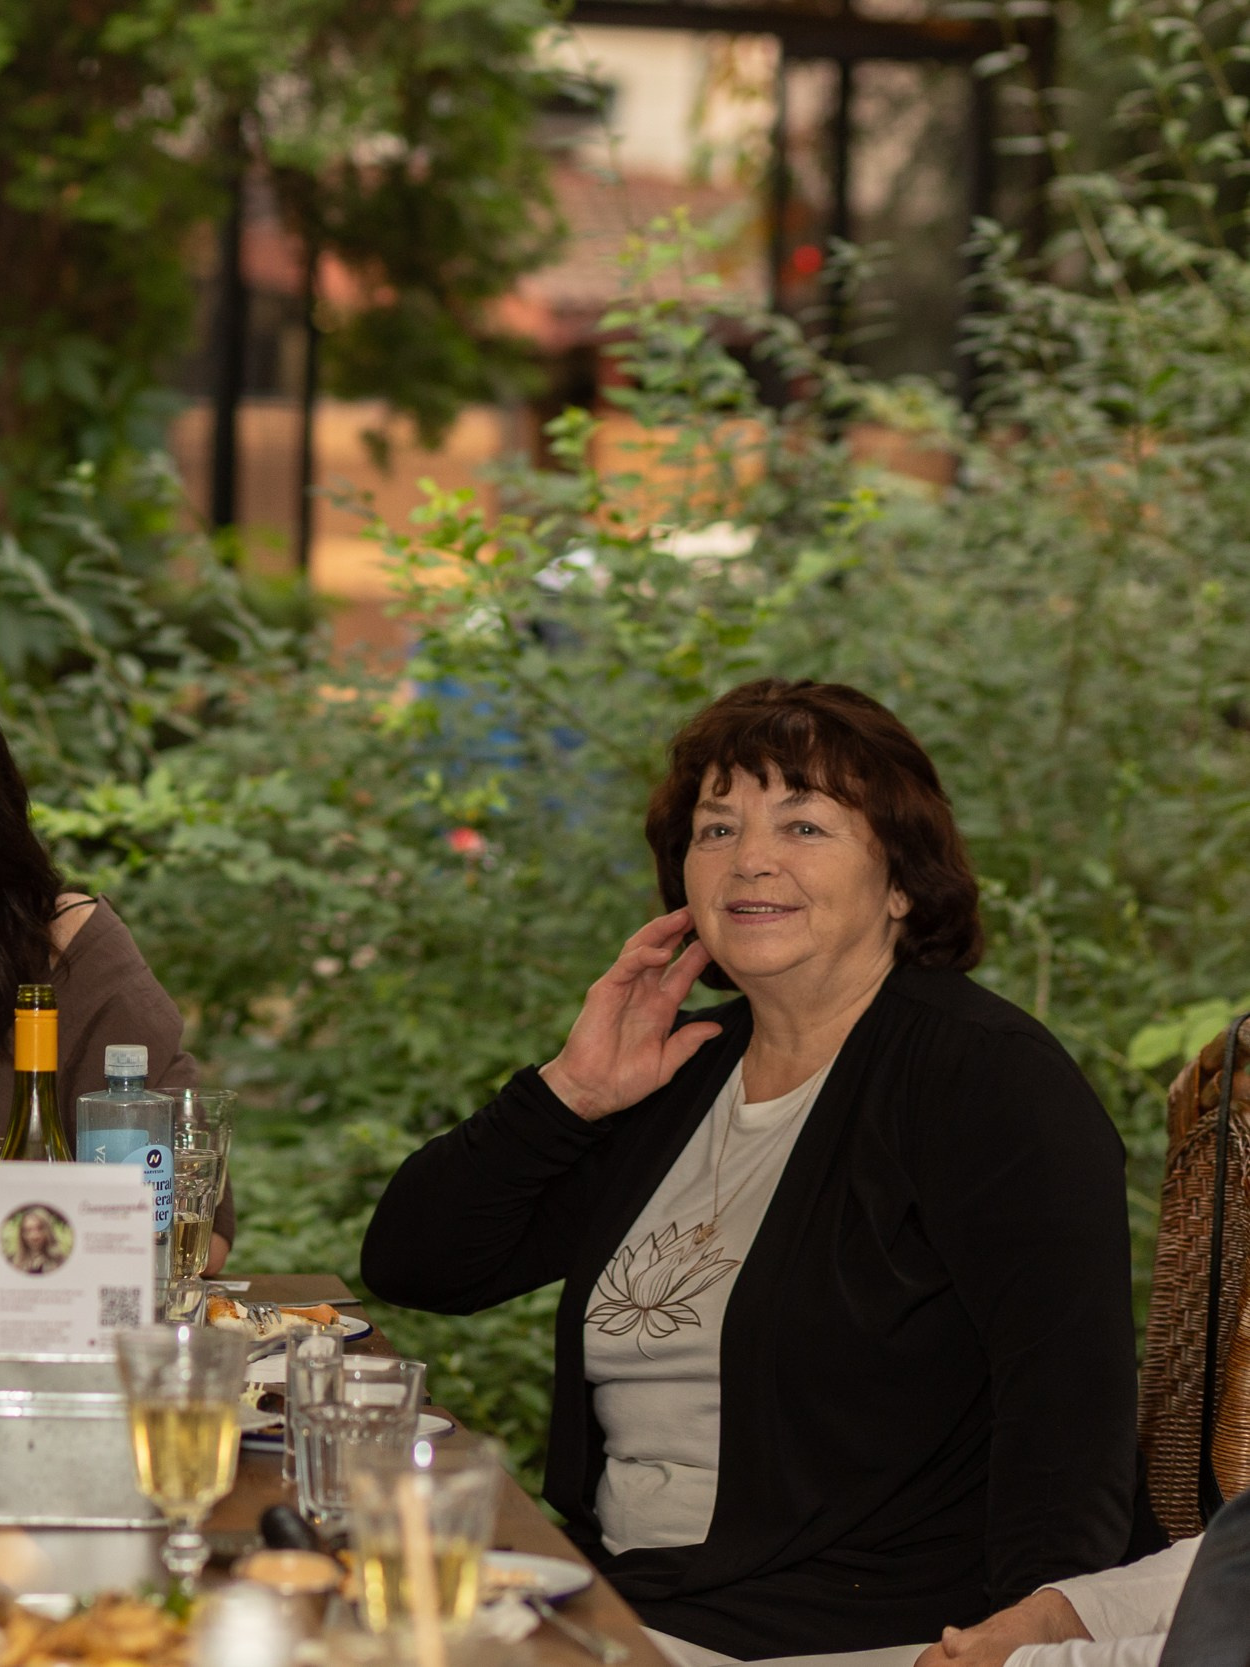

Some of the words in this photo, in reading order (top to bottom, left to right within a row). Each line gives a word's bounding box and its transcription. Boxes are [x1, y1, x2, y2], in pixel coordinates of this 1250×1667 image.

[143, 1177, 172, 1191] ural
[153, 1192, 173, 1206] eral
[152, 1209, 169, 1222] ter
